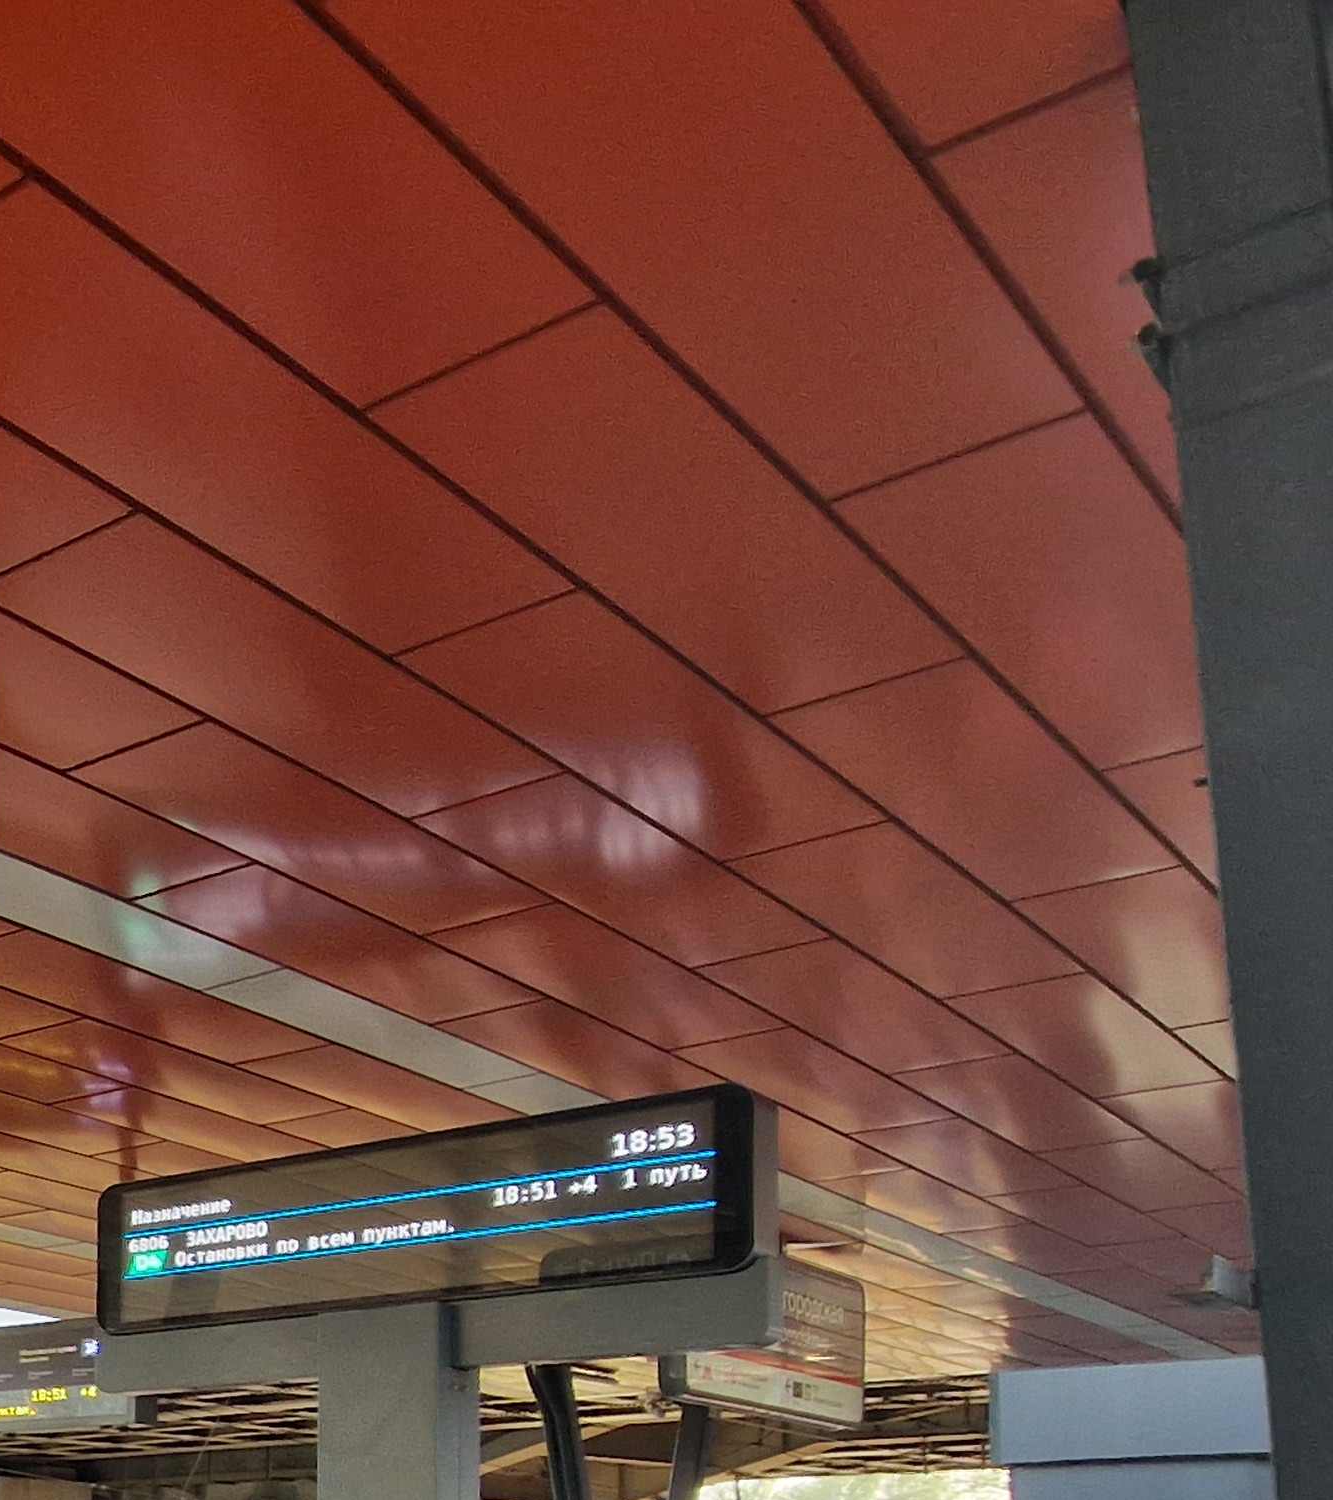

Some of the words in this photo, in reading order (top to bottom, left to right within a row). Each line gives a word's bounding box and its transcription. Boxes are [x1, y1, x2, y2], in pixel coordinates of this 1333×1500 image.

[611, 1122, 695, 1157] 18:53
[128, 1235, 169, 1253] 6806
[186, 1221, 268, 1247] ЗАХАРОВО
[492, 1180, 558, 1207] 18:51
[568, 1174, 598, 1195] +4
[622, 1168, 637, 1190] 1
[649, 1162, 708, 1188] путь
[131, 1199, 232, 1226] Назначение
[174, 1243, 269, 1267] Остановки
[276, 1239, 299, 1255] по
[307, 1231, 356, 1250] всем
[362, 1219, 454, 1244] пунктам.
[31, 1387, 68, 1402] 18:51
